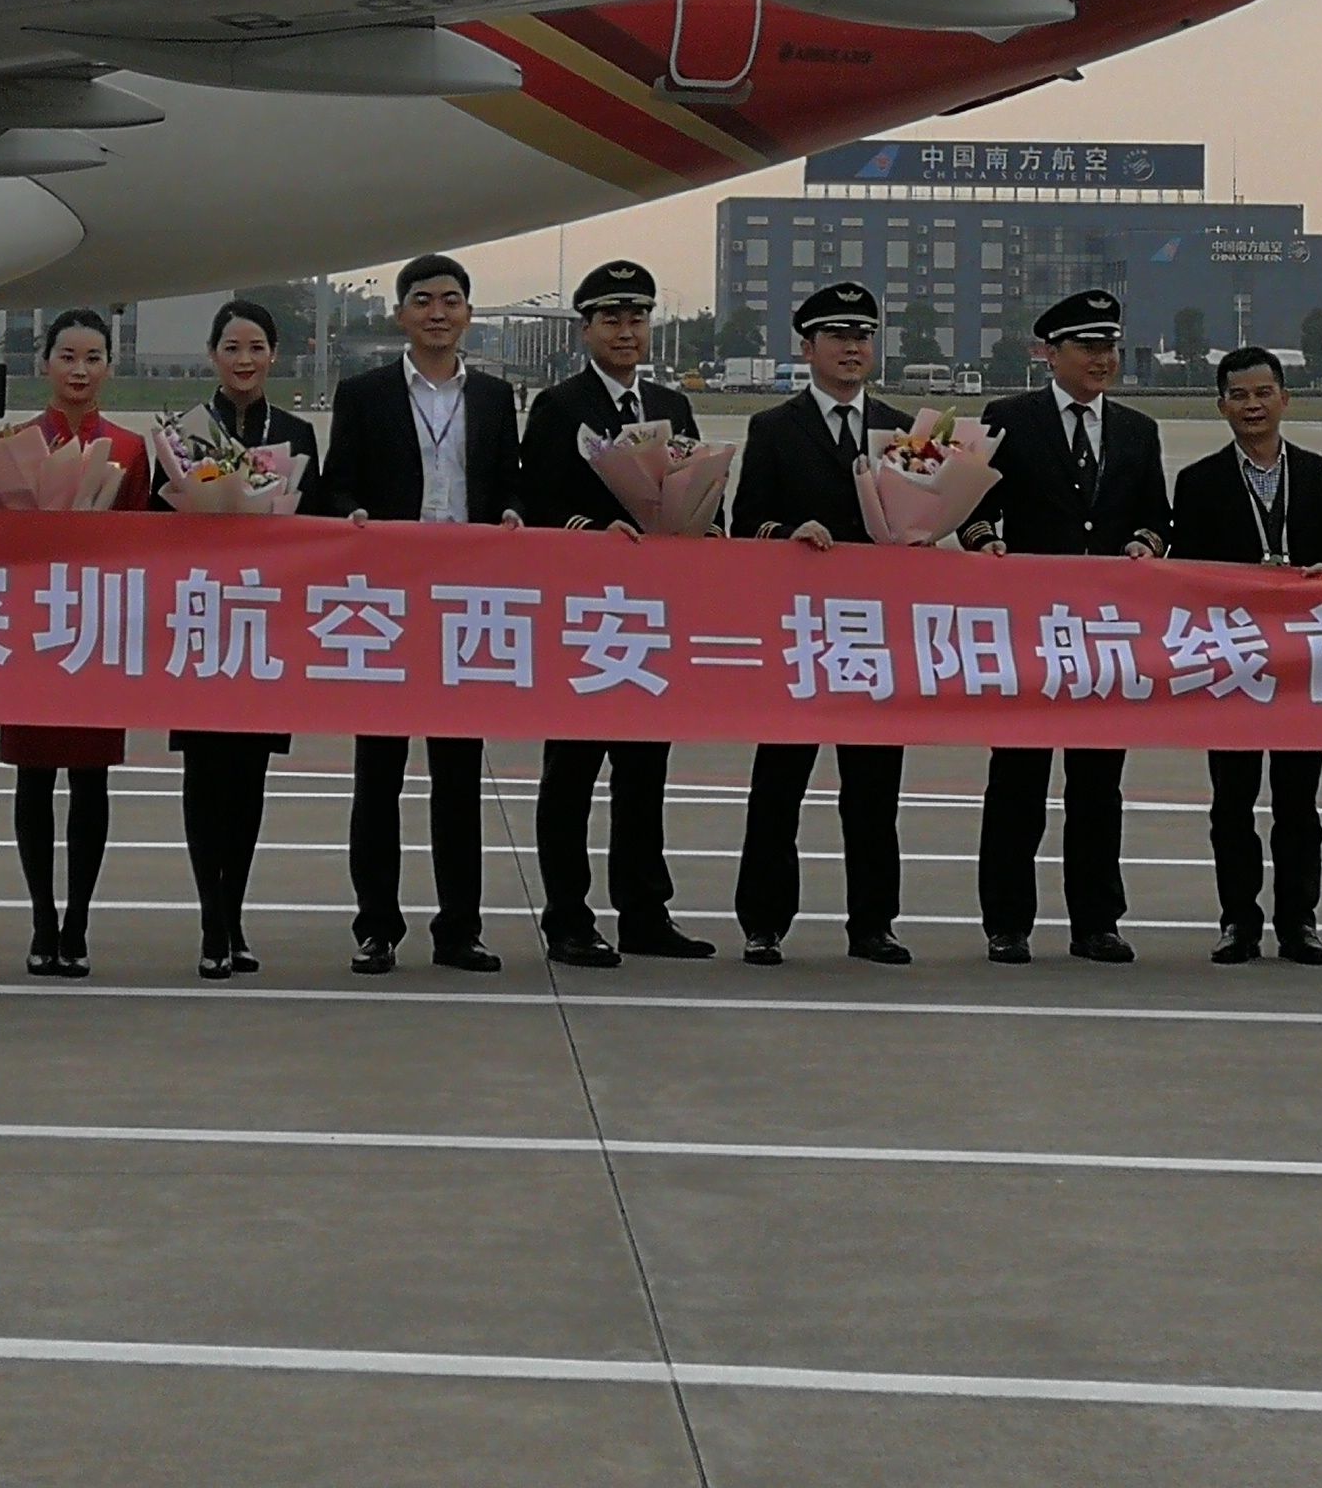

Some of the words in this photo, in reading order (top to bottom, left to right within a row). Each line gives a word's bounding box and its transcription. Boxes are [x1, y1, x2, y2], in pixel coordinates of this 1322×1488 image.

[921, 145, 1108, 172] 中国南方航空
[923, 170, 987, 180] CHINA
[999, 171, 1107, 181] SOUTHERN
